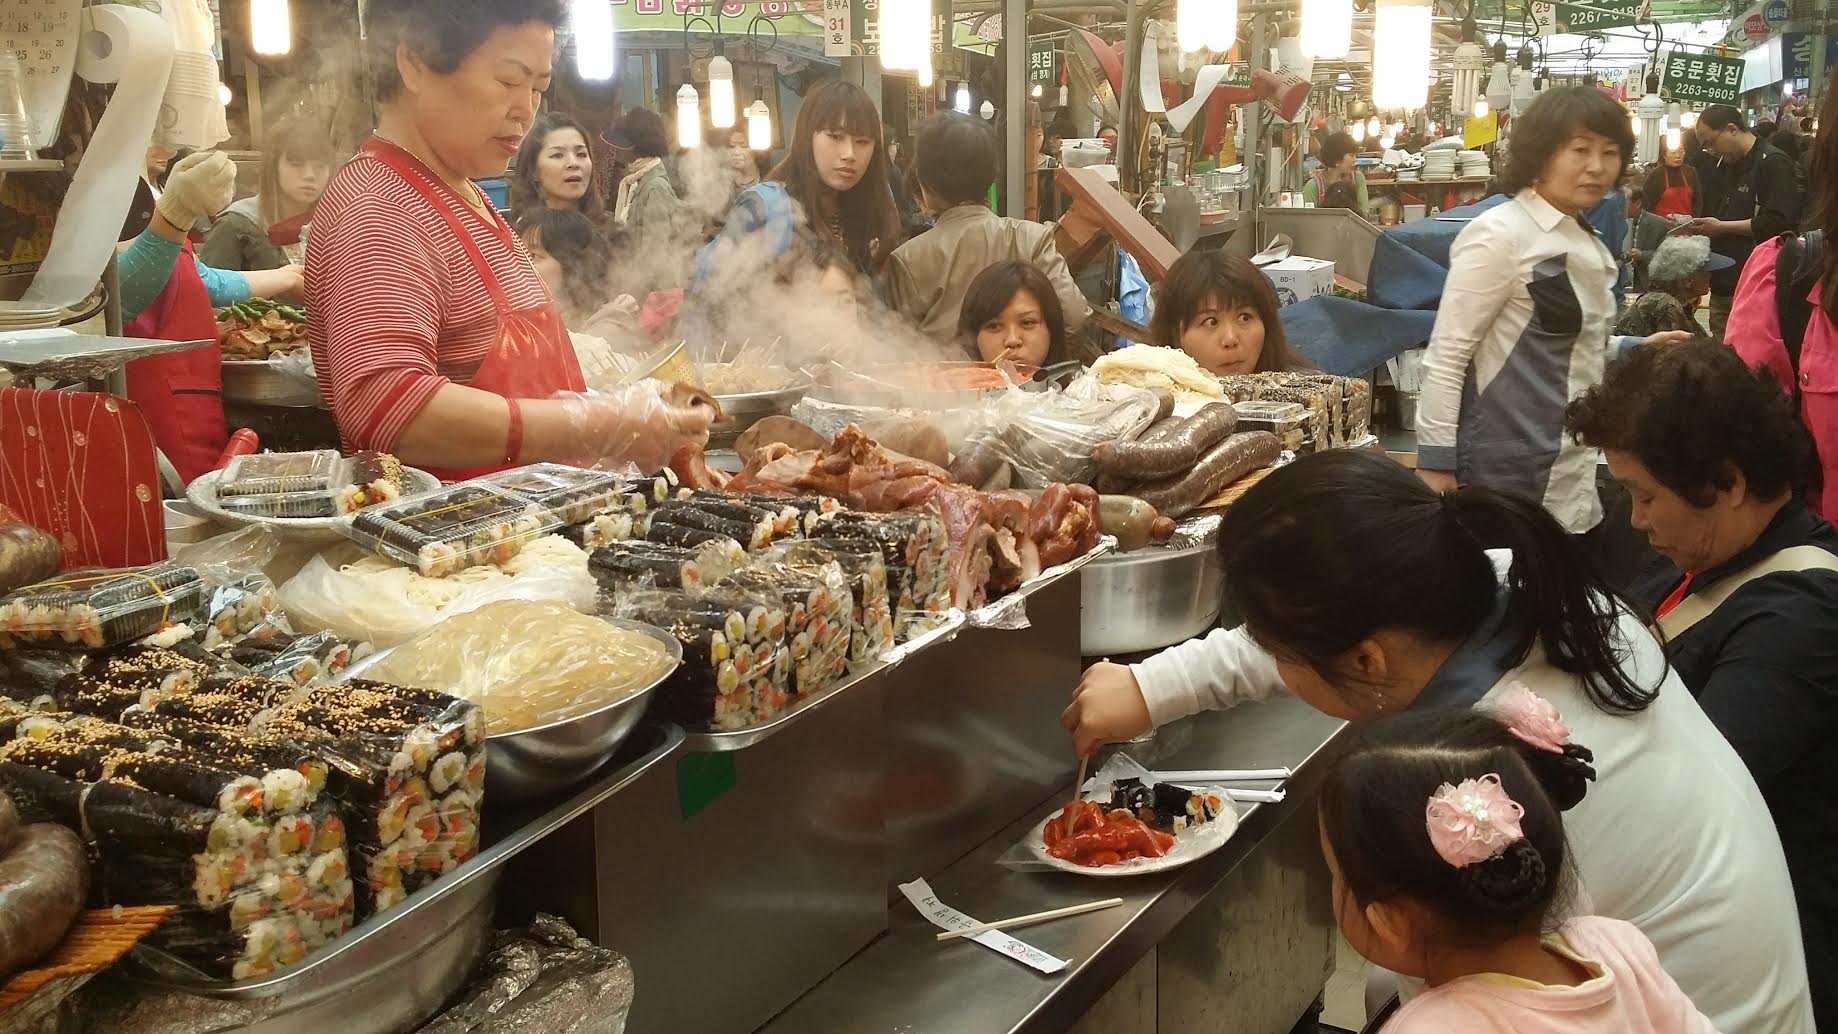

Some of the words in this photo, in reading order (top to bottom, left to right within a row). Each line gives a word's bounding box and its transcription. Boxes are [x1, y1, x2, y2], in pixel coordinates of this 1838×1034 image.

[829, 17, 844, 31] 31
[831, 32, 844, 45] 호
[40, 49, 53, 60] 26
[1670, 57, 1741, 86] 종문횟집
[1675, 83, 1735, 101] 2263-9605
